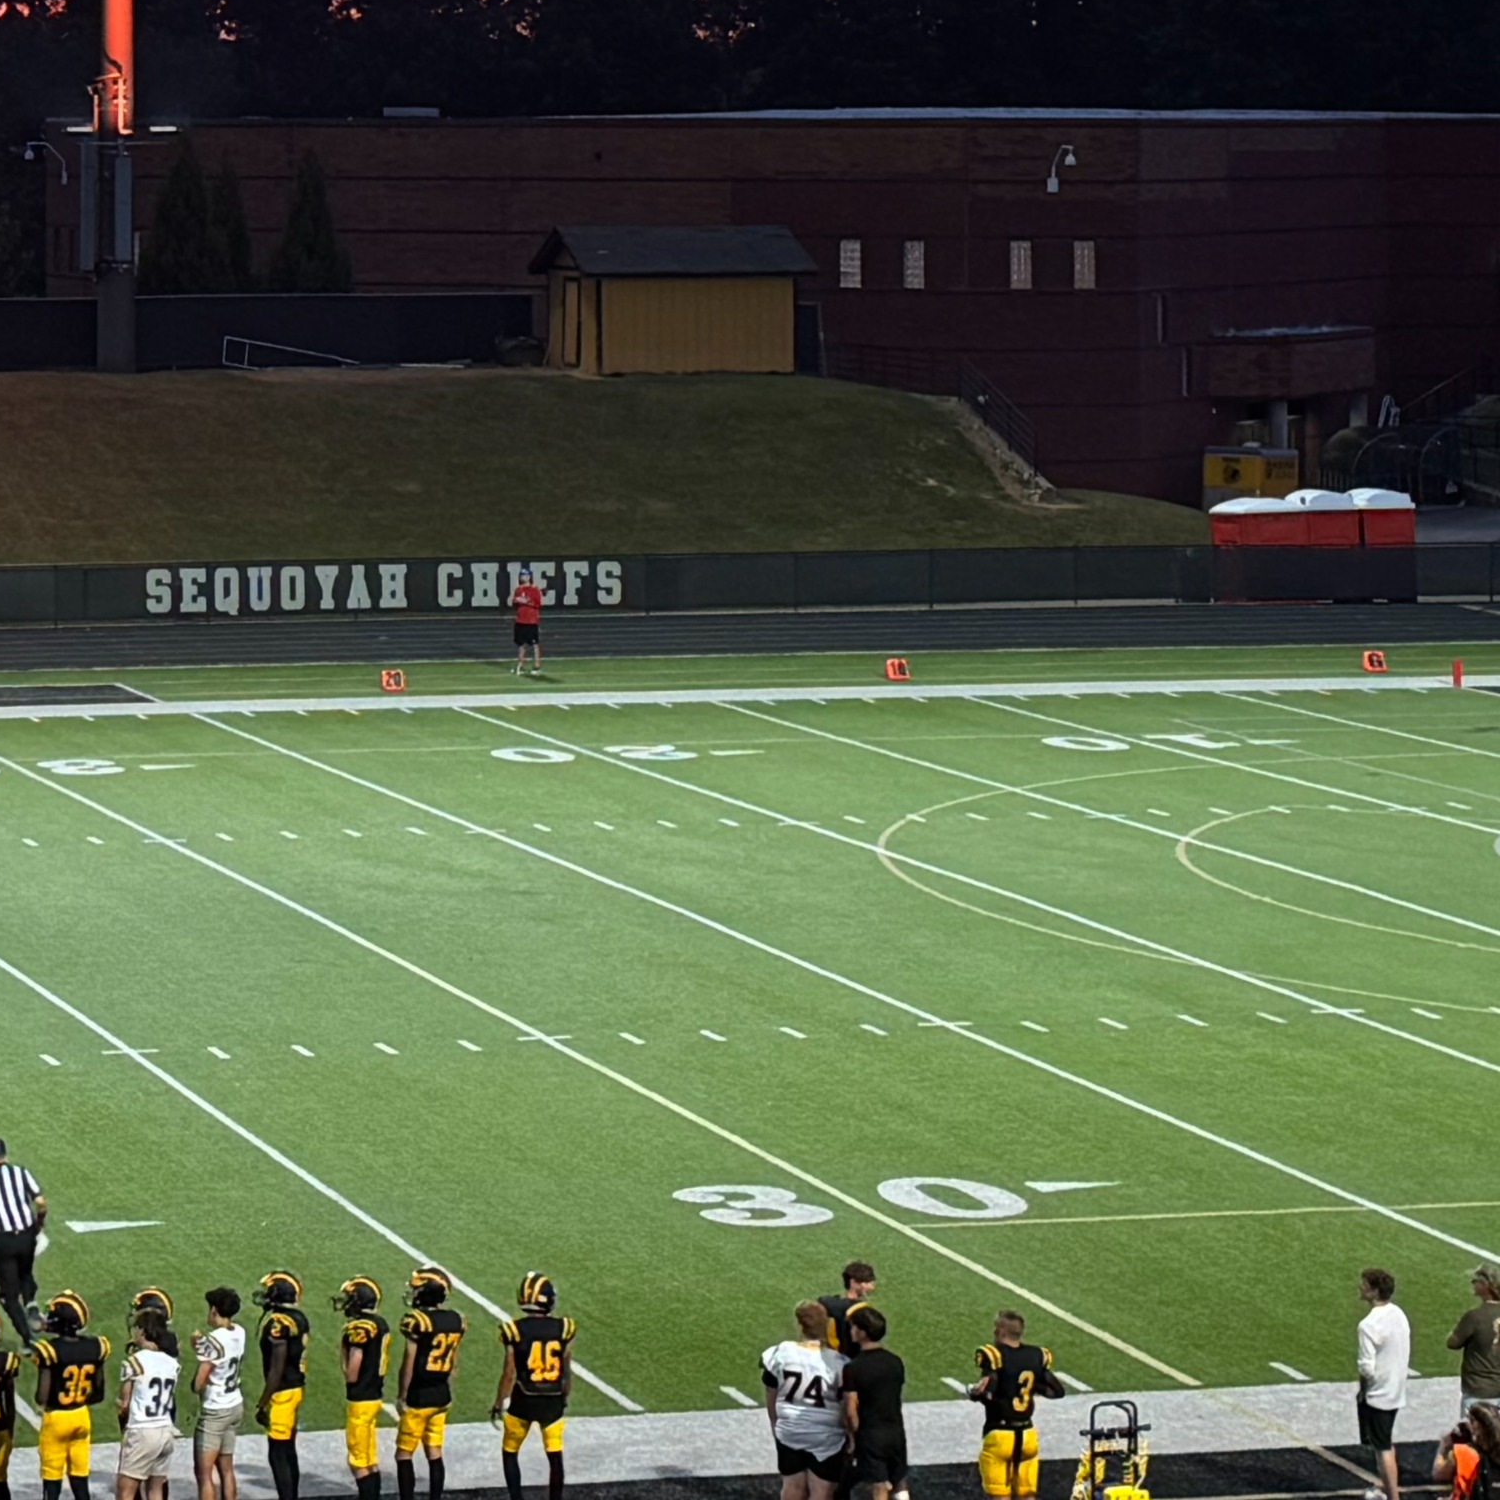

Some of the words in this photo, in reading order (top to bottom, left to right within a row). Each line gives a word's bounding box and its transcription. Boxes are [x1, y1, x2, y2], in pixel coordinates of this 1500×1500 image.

[146, 563, 408, 616] SEQUOYAH
[426, 1333, 461, 1372] 27
[781, 1369, 826, 1408] 74
[1013, 1370, 1035, 1412] 3
